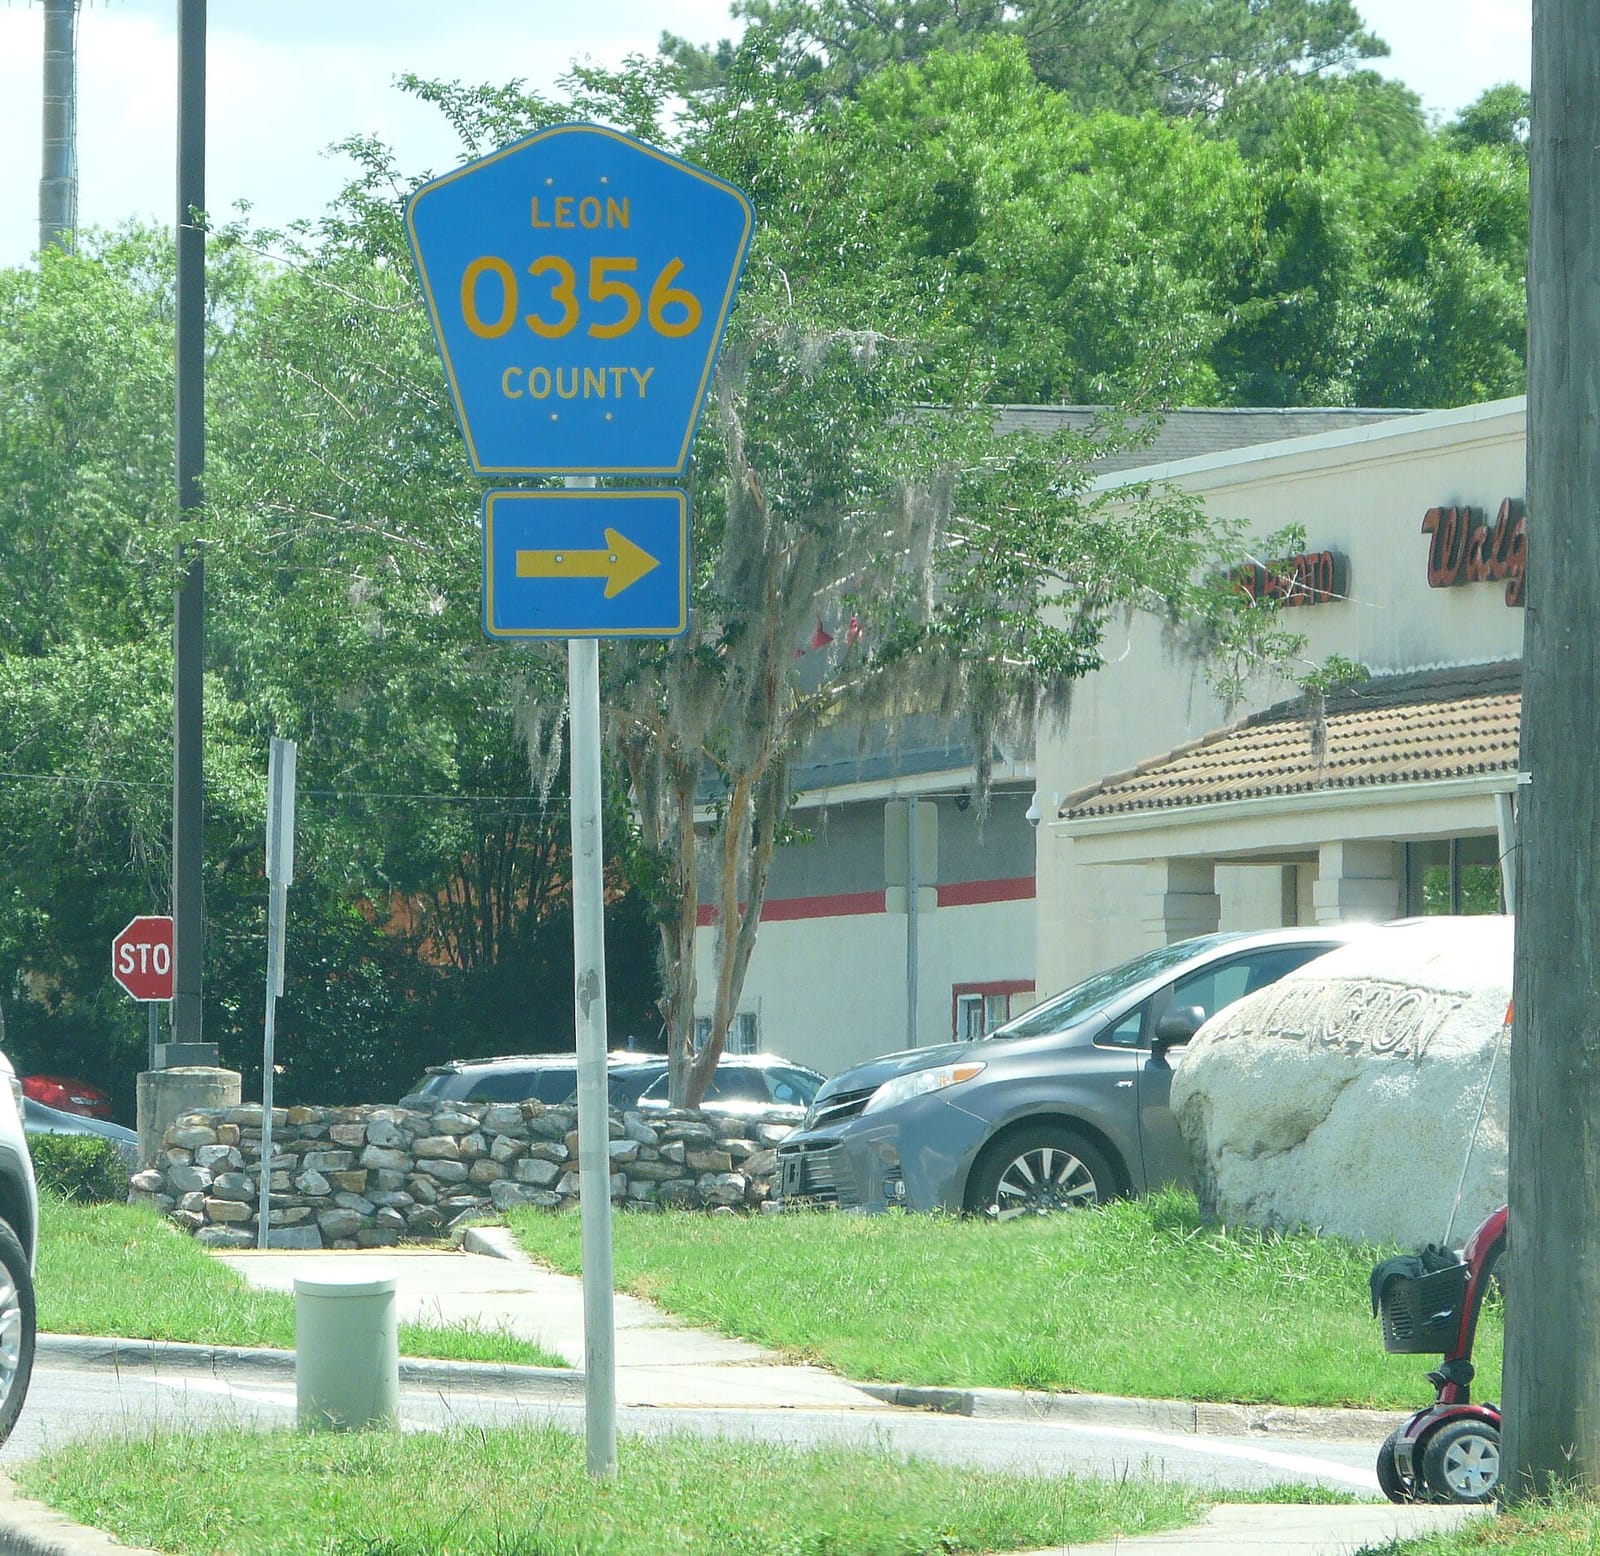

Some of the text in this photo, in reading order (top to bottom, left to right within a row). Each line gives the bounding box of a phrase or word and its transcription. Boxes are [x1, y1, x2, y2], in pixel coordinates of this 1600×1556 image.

[531, 196, 631, 229] LEON
[460, 255, 703, 339] 0356
[502, 367, 655, 399] COUNTY
